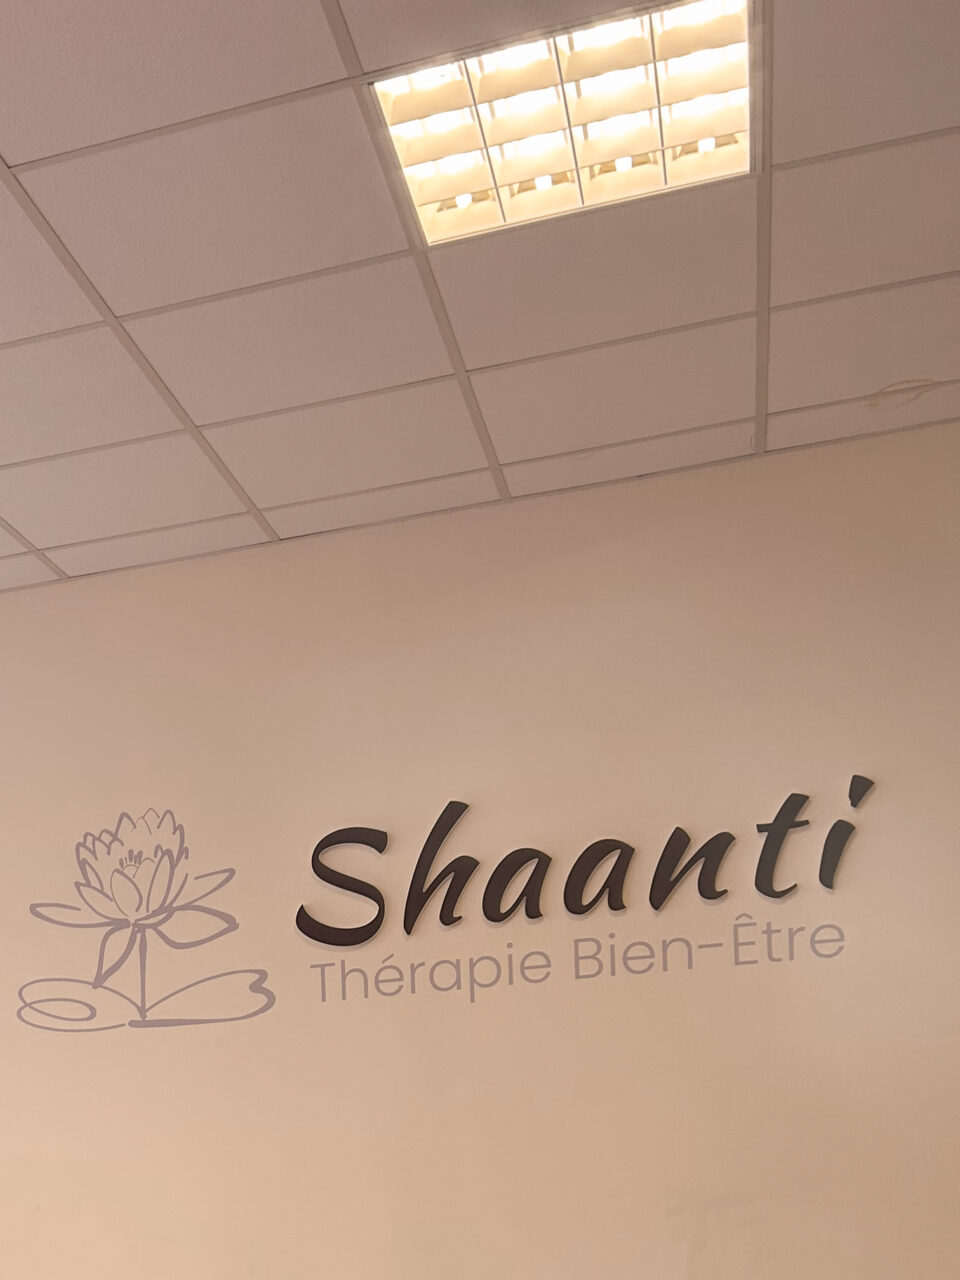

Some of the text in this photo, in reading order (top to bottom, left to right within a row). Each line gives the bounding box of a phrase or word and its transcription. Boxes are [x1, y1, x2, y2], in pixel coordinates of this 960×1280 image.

[295, 774, 875, 948] Shaanti
[309, 912, 845, 1004] Thérapie Bien-Être
